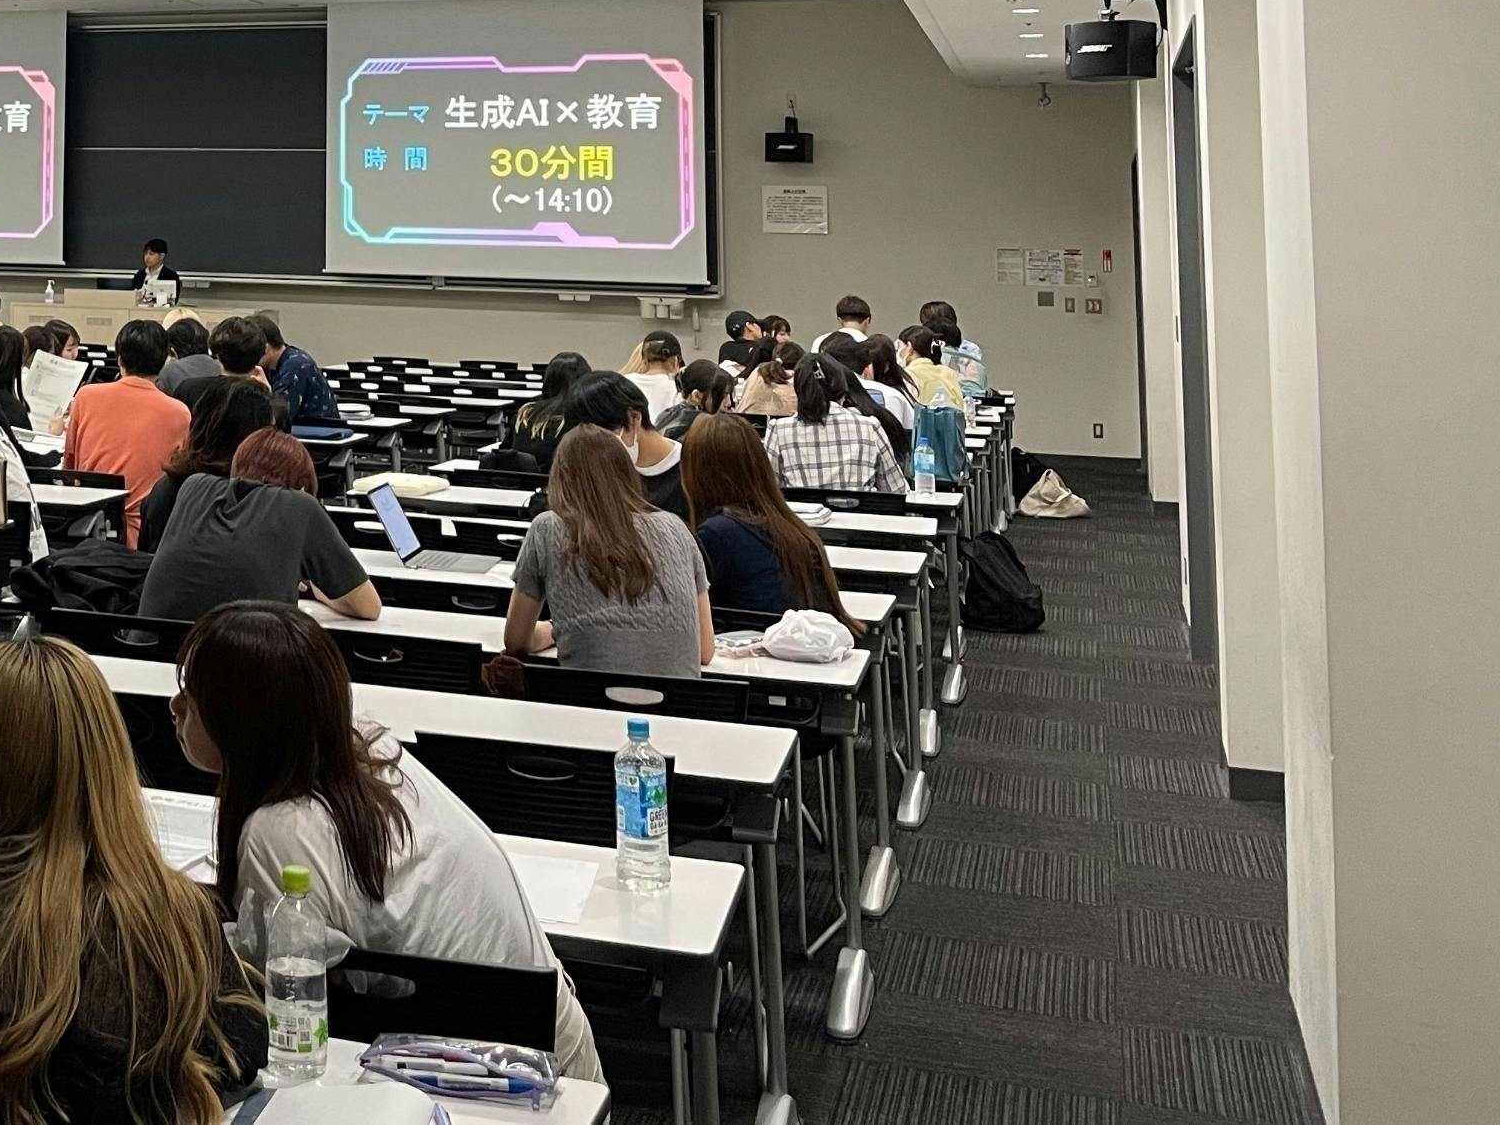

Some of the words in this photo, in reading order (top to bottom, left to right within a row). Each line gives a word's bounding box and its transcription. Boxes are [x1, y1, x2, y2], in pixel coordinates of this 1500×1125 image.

[362, 103, 430, 125] テーマ
[489, 145, 614, 181] 30分間
